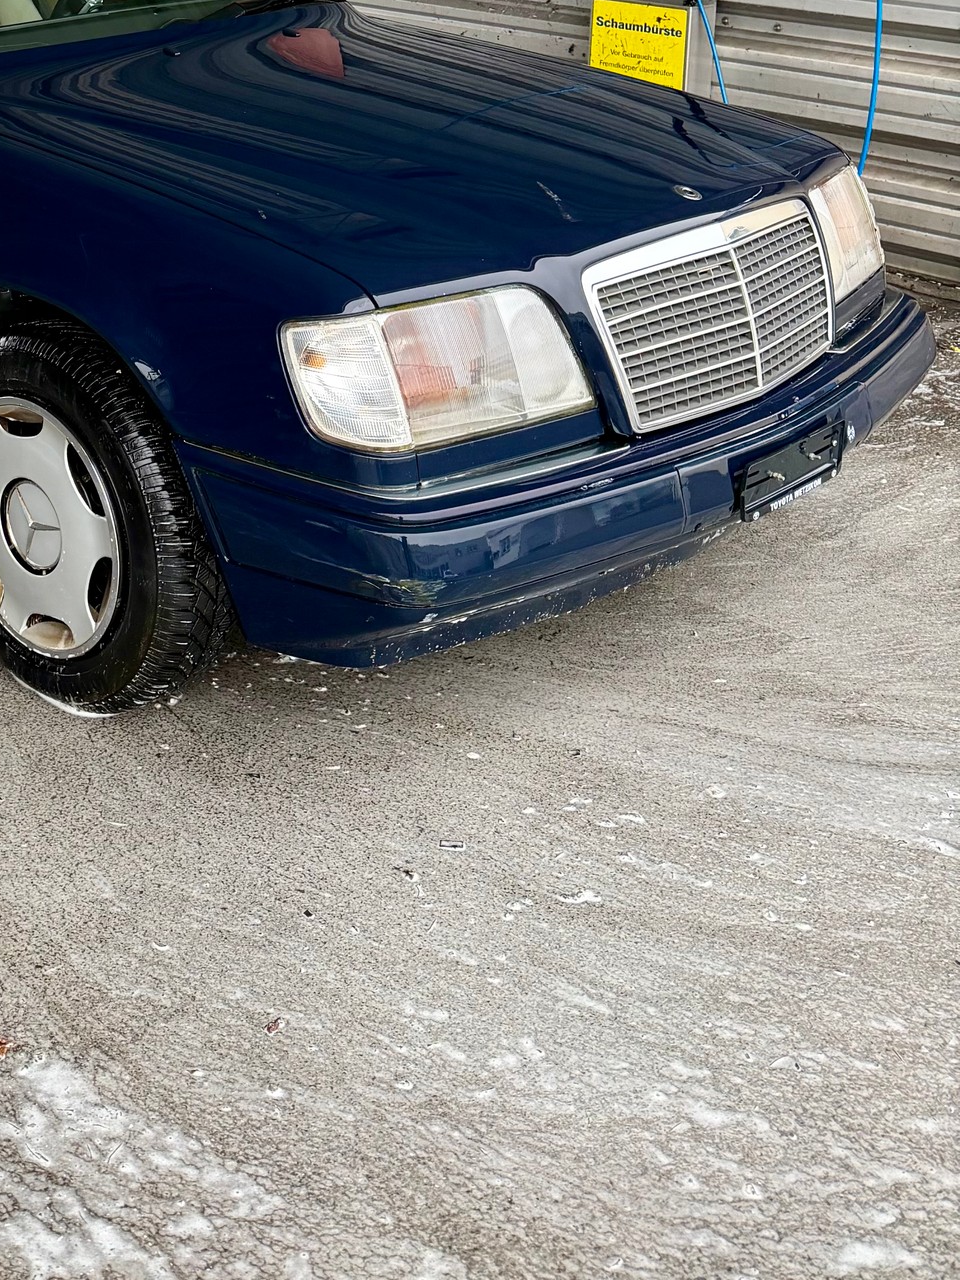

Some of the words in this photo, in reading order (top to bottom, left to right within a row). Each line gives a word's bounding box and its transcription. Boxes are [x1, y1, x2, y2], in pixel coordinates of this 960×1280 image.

[596, 16, 683, 38] Schaumbürste
[609, 48, 621, 56] Vor
[622, 49, 652, 61] Gebrauch
[599, 59, 638, 71] Fremdkörper
[770, 493, 794, 511] TOYOTA
